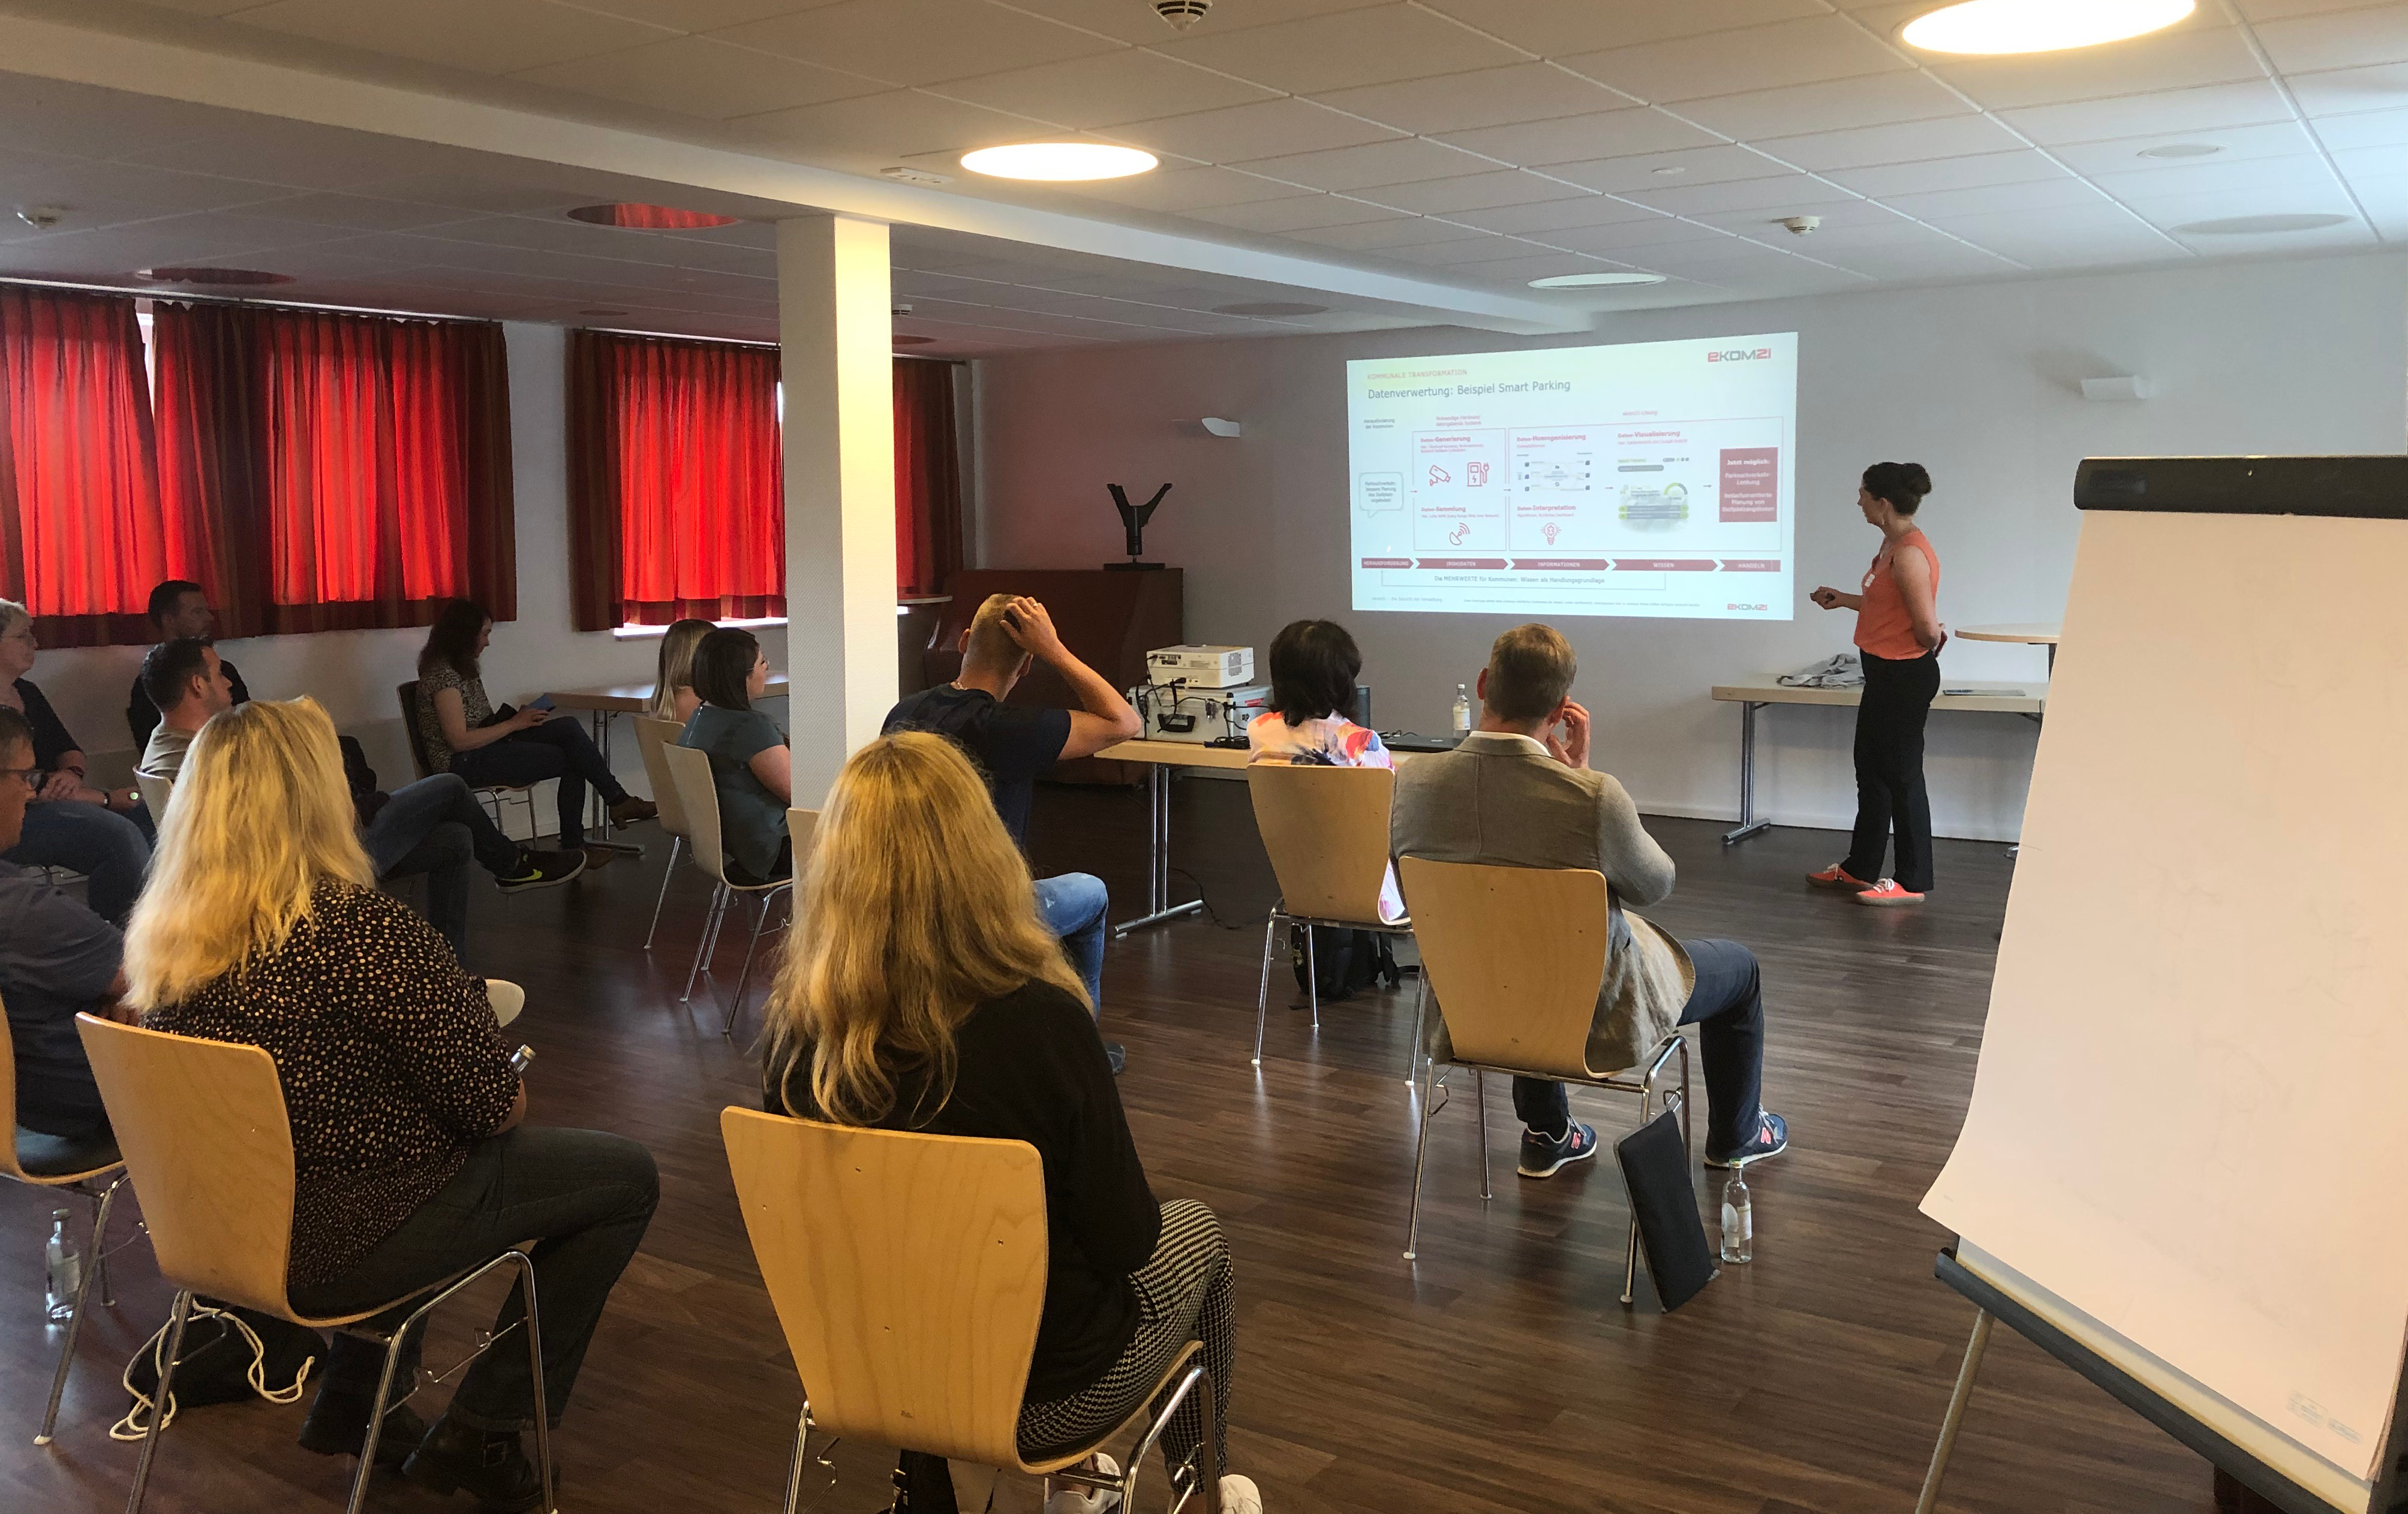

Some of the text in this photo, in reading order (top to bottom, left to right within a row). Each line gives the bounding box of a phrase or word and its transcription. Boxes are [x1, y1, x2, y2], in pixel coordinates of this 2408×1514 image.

[1367, 369, 1468, 380] KOMMUNALE TRANSFORMATION
[1368, 380, 1571, 399] Datenverwertung: Beispiel Smart Parking
[1761, 1127, 1771, 1144] N
